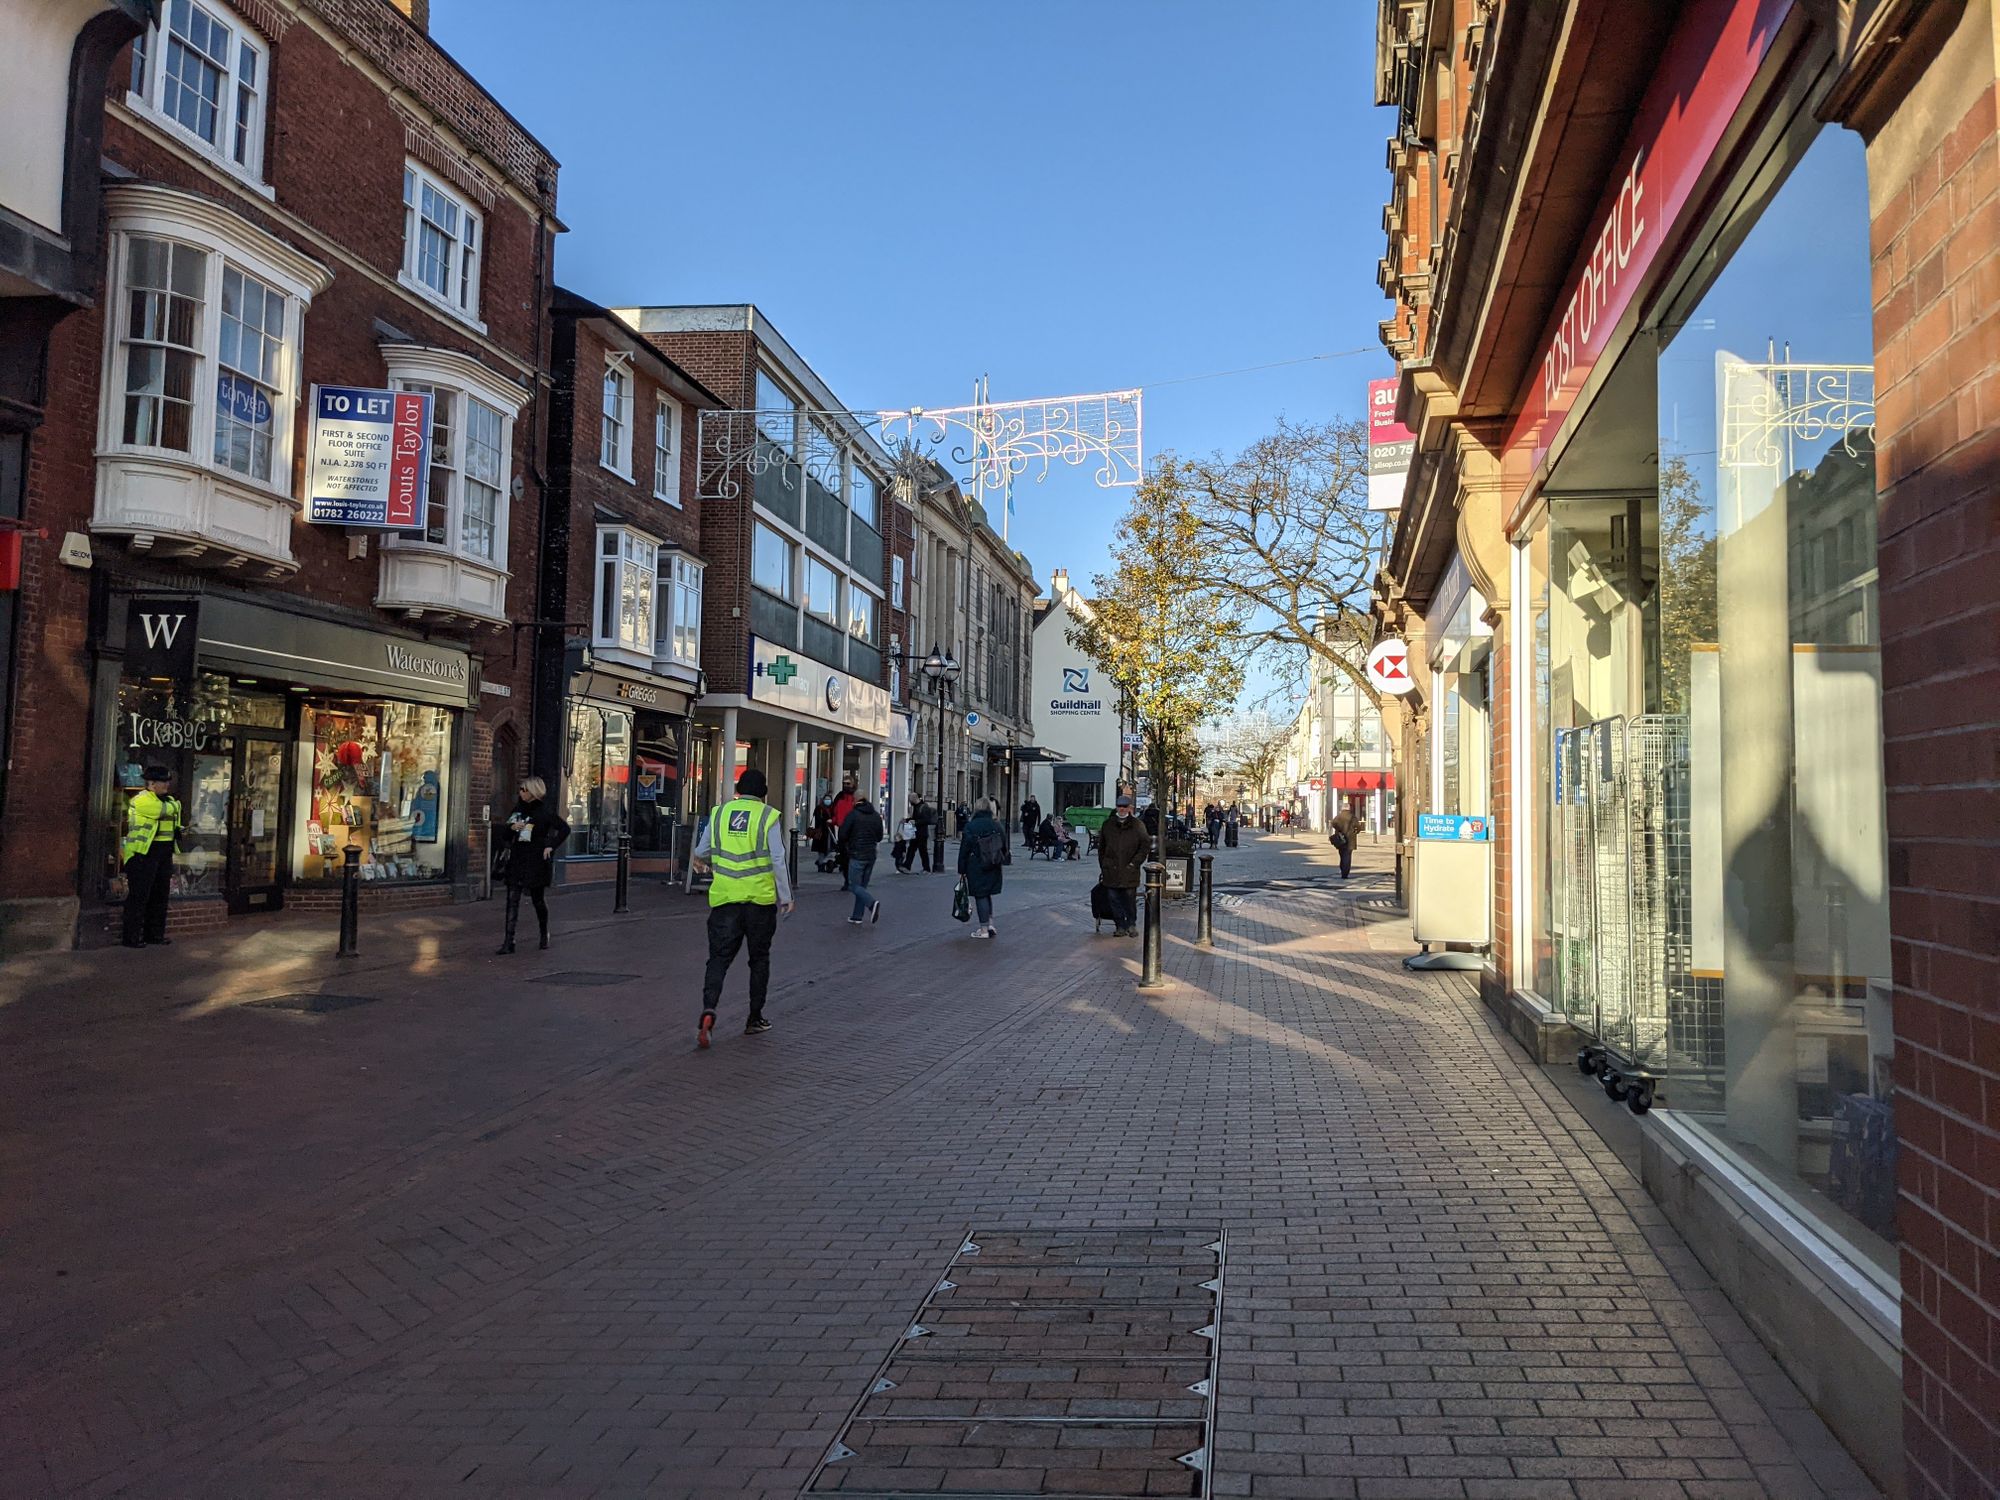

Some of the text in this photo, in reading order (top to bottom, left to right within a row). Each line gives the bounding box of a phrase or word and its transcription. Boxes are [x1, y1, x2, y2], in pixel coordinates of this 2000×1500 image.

[1544, 144, 1645, 418] POST OFFICE
[325, 394, 390, 415] TO LET
[322, 429, 344, 438] FIRST
[356, 432, 390, 441] SECOND
[328, 440, 382, 451] FLOOR OFFICE
[1374, 446, 1396, 458] 020
[320, 458, 341, 467] N.I.A.
[365, 461, 376, 469] SQ
[391, 400, 424, 518] Louis Taylor
[327, 475, 379, 485] WATERSTONES
[343, 484, 378, 492] AFFECTED
[315, 500, 384, 510] www.louis-taylor.co.uk
[313, 508, 384, 521] 01782 260222
[139, 614, 187, 649] W
[385, 644, 466, 680] Waterstone's
[628, 685, 657, 703] GREGGS
[1050, 699, 1101, 709] Guildhall
[1424, 816, 1455, 825] Time to
